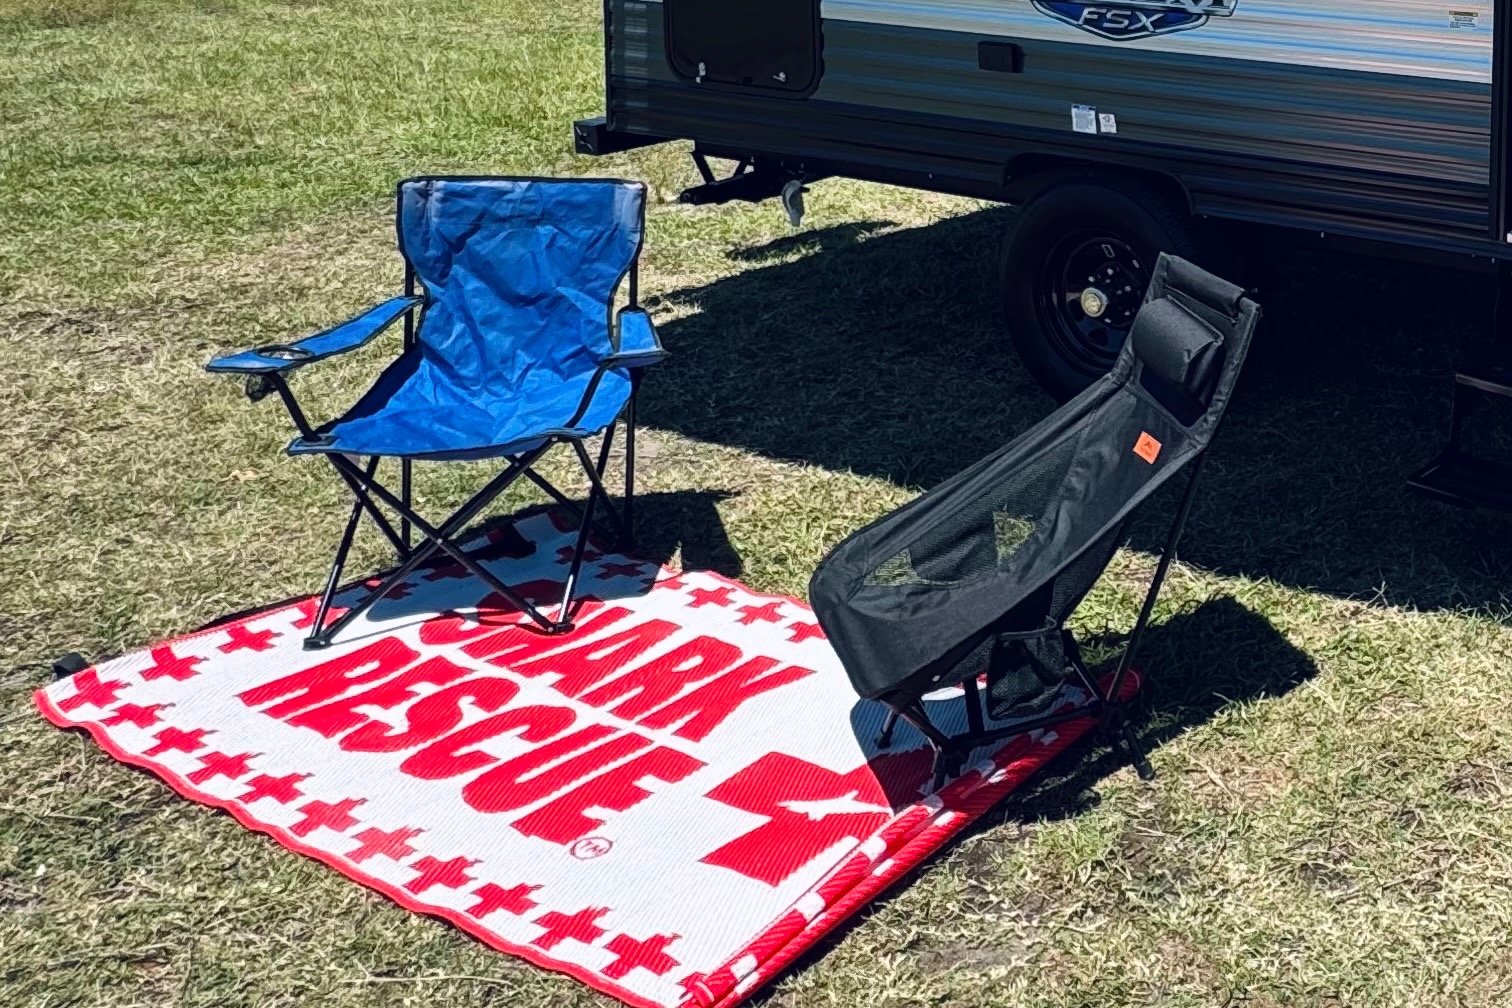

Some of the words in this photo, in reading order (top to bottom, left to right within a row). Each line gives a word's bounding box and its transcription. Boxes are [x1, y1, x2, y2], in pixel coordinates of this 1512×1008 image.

[1078, 7, 1165, 33] FSX
[236, 635, 708, 845] RESCUE
[418, 578, 818, 743] SHARK
